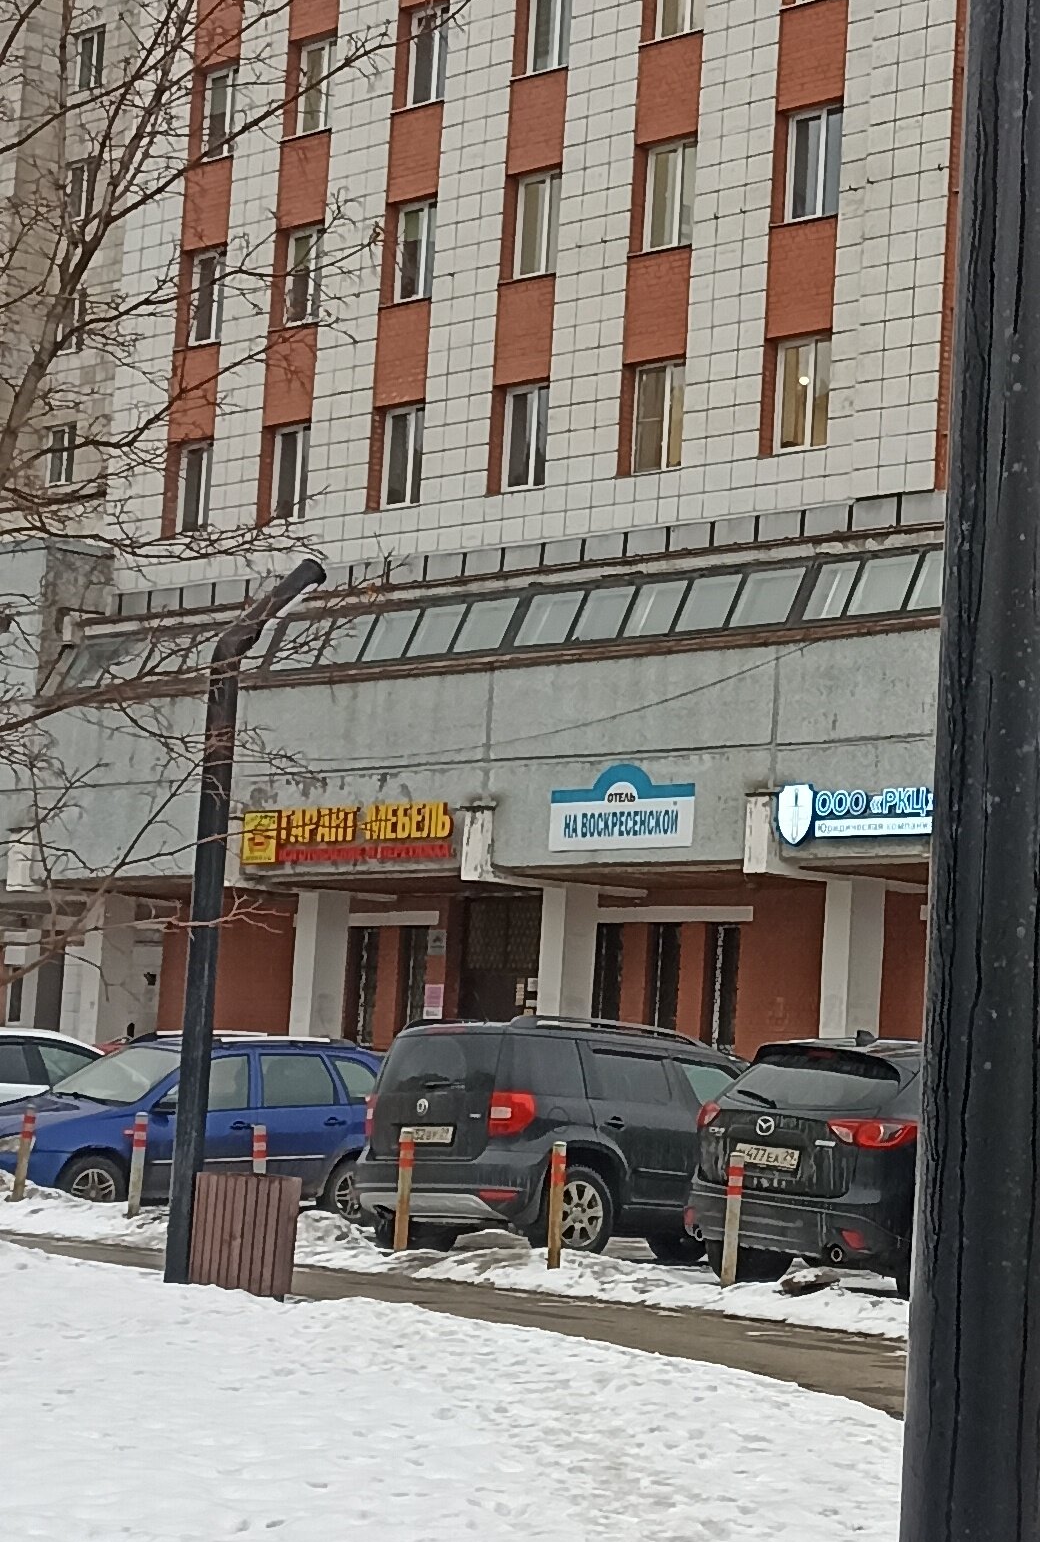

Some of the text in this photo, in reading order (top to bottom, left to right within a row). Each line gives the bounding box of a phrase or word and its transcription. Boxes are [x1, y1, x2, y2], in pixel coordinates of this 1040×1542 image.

[607, 792, 636, 803] ОТЕЛЬ
[815, 790, 867, 816] ООО
[563, 800, 680, 839] НА ВОСКРЕСЕНСКОЙ
[886, 822, 929, 831] компани
